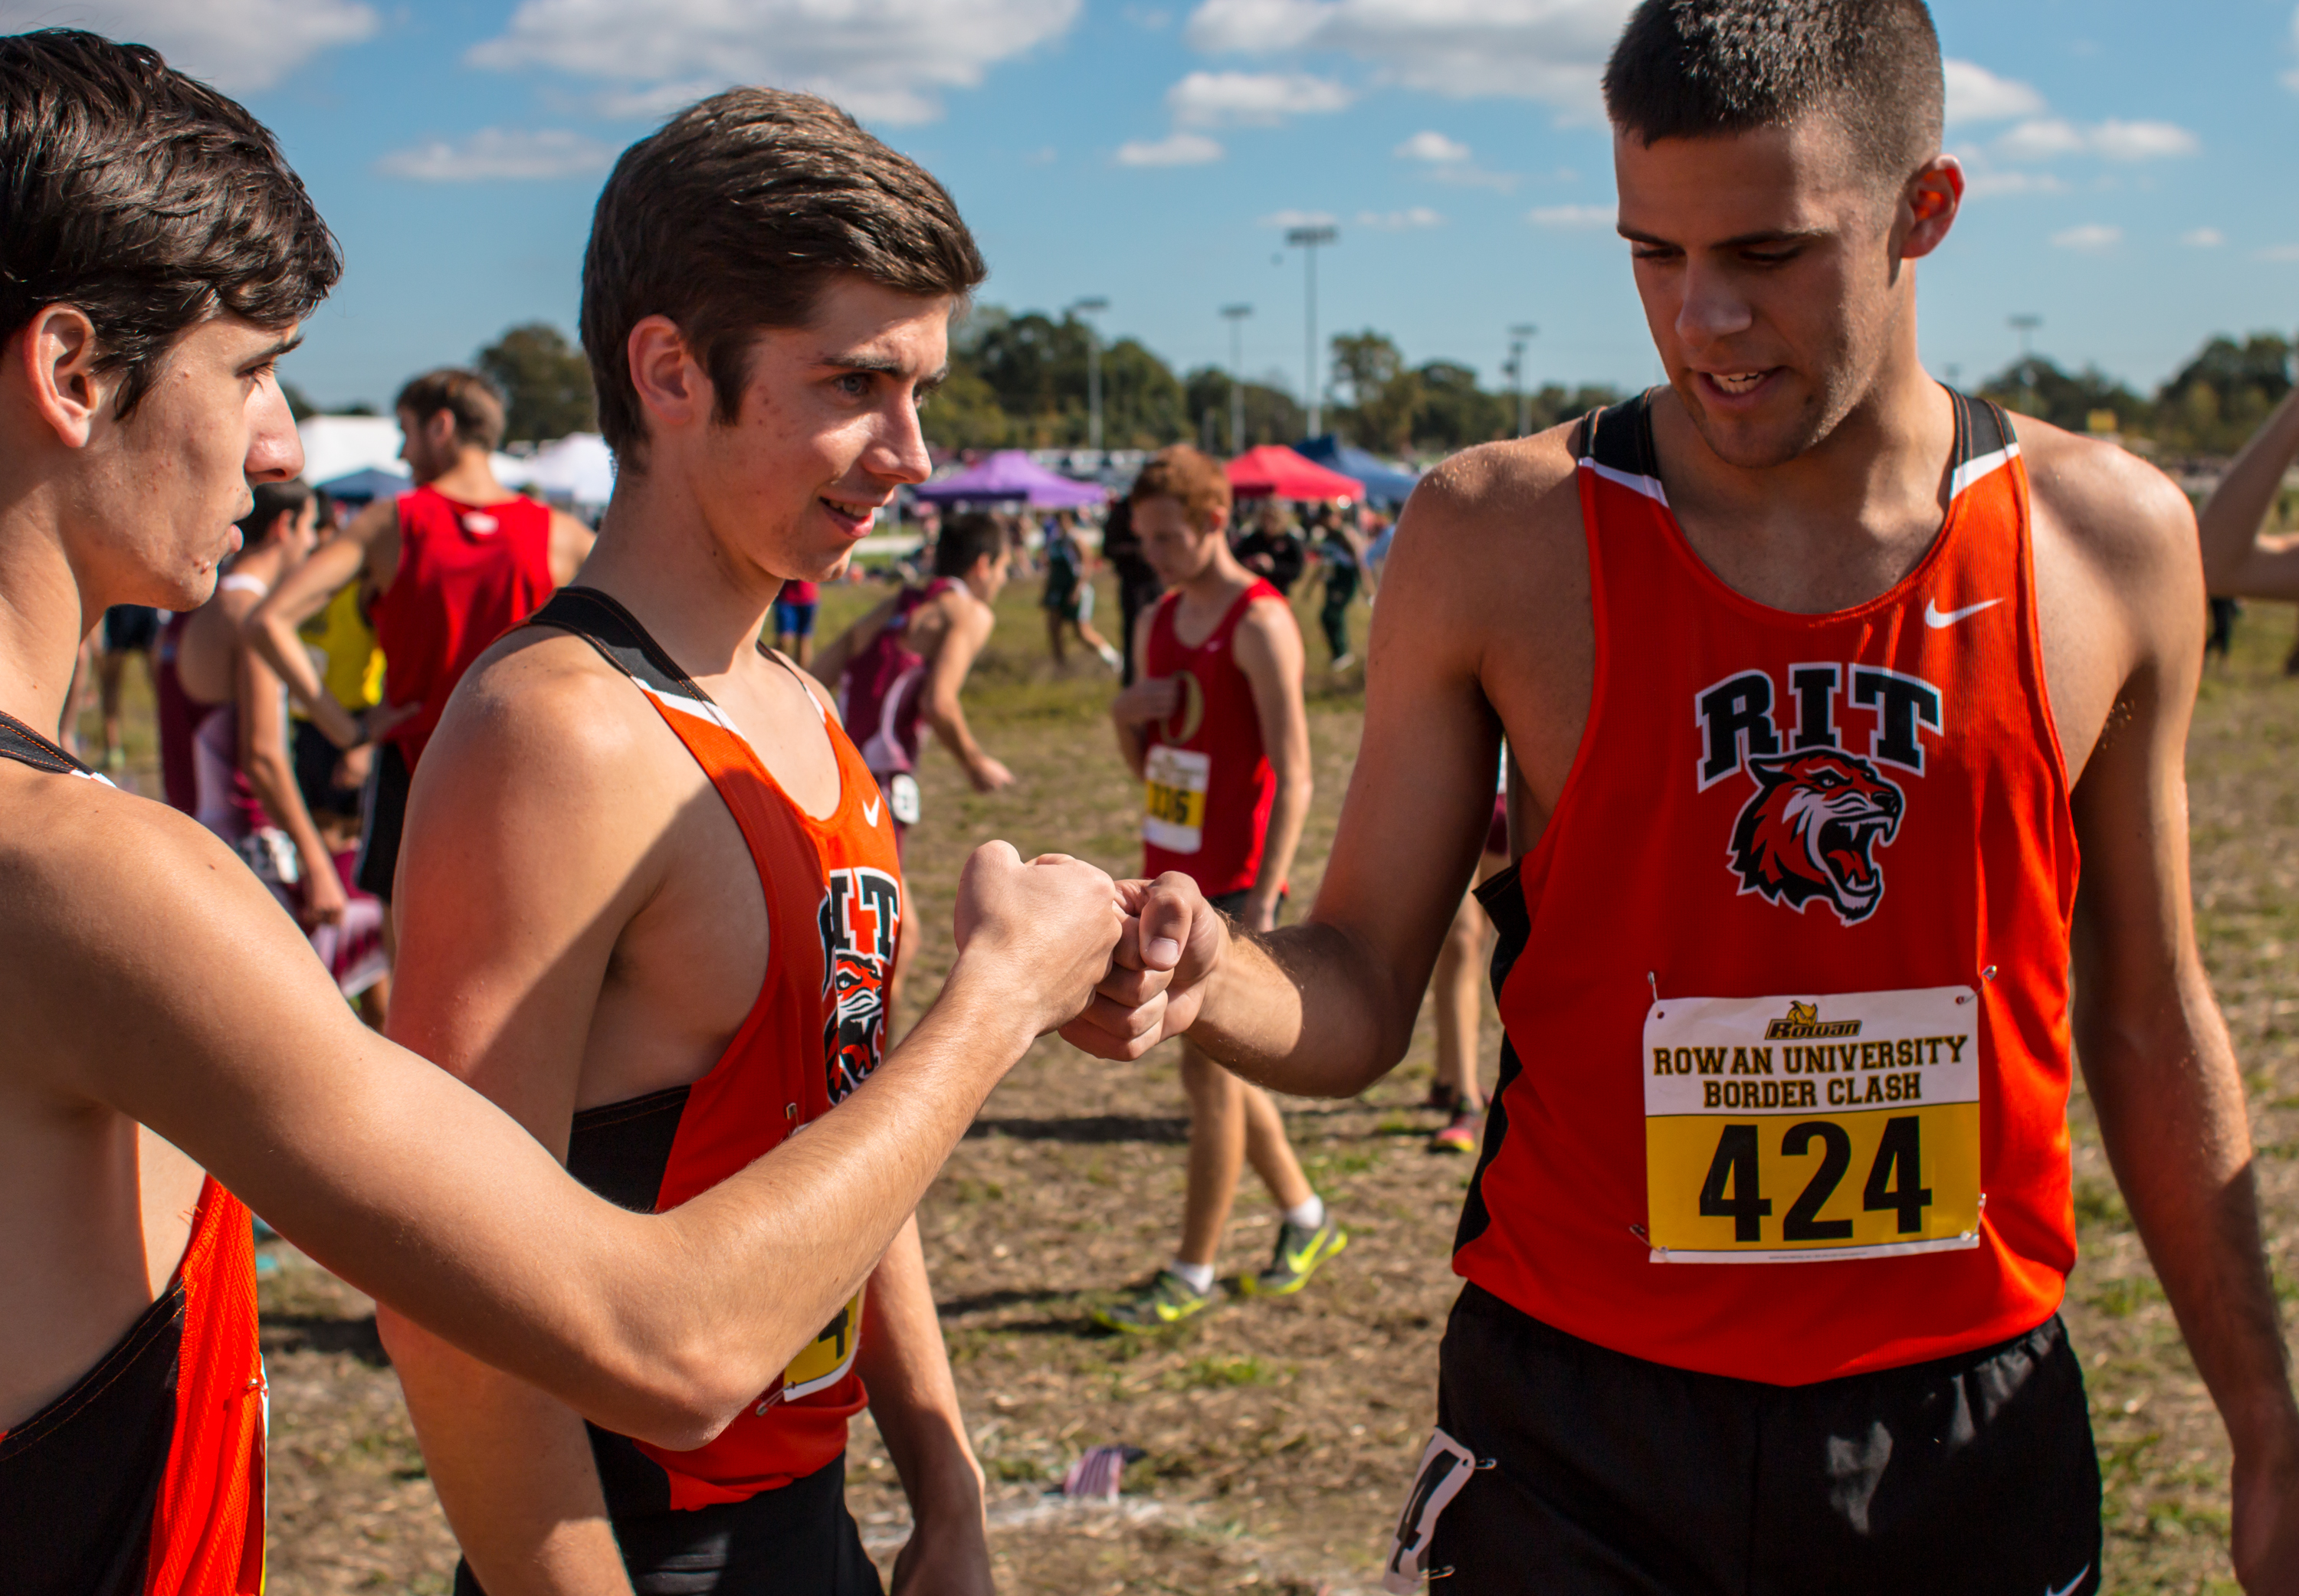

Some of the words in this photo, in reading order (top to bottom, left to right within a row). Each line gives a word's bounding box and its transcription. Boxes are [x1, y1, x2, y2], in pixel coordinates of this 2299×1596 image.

[1695, 662, 1943, 793] RIT
[1765, 1019, 1862, 1040] Rowan
[1653, 1047, 1774, 1075] ROWAN
[1782, 1035, 1968, 1074] UNIVERSITY
[1703, 1080, 1817, 1108] BORDER
[1827, 1072, 1921, 1106] CLASH
[1699, 1116, 1932, 1242] 424
